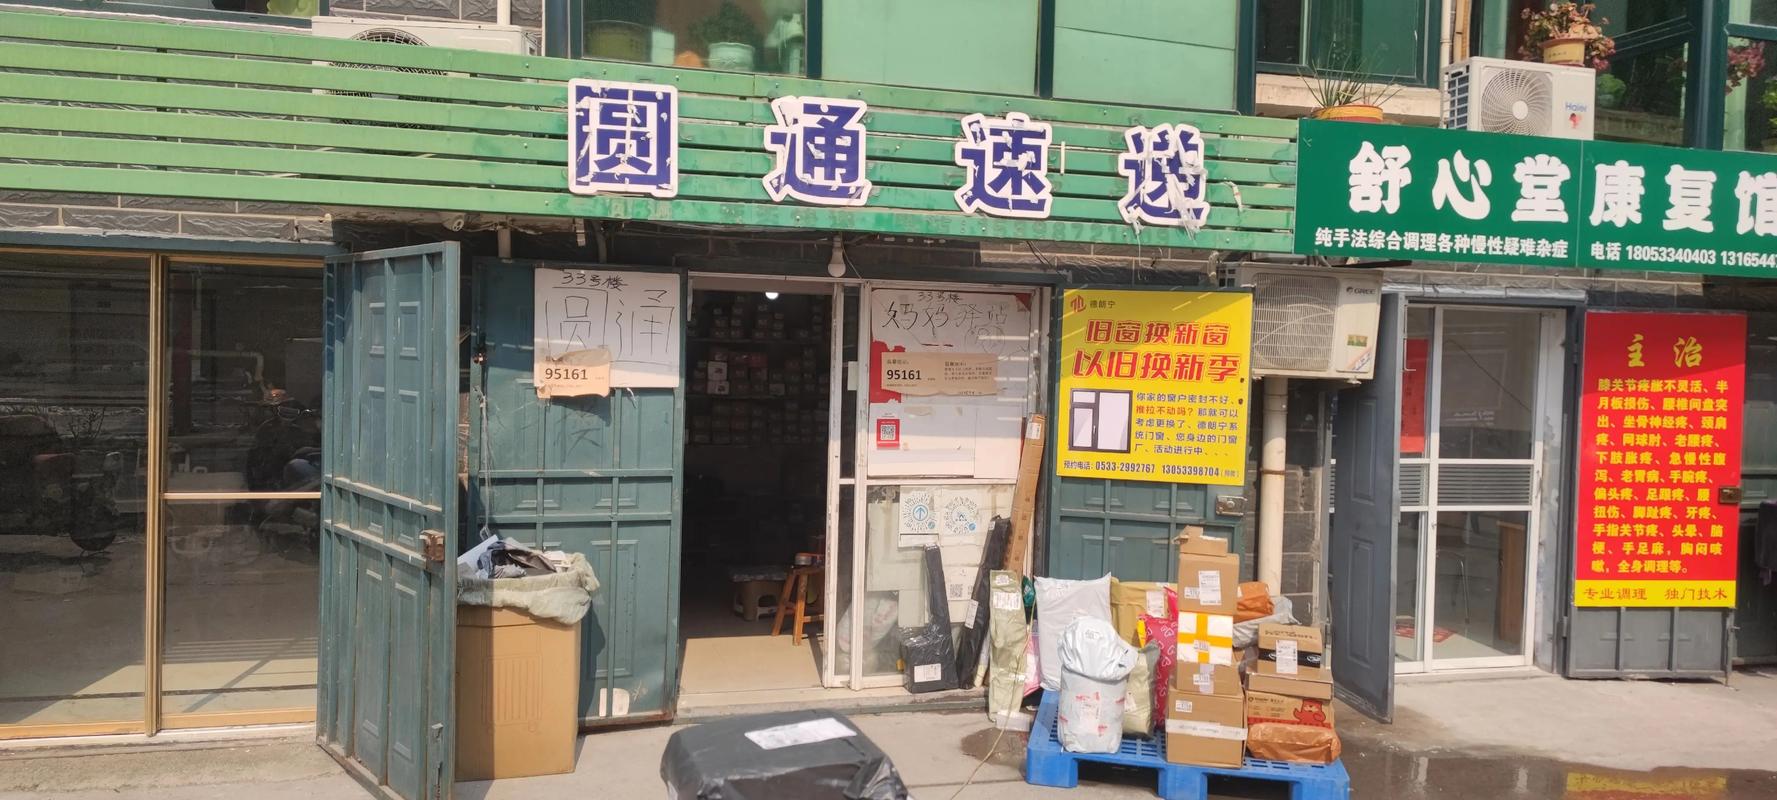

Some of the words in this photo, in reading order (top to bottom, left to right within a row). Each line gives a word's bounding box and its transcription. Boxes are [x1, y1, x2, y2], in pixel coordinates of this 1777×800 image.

[1314, 227, 1569, 258] 纯手法综合调理各种慢性疑难杂症
[1590, 241, 1622, 261] 电话
[1626, 245, 1716, 265] 18053340403
[1720, 250, 1777, 268] 1316544
[1086, 319, 1230, 346] 旧窗换新窗
[545, 368, 588, 381] 95161
[886, 369, 922, 381] 95161
[1073, 350, 1241, 382] 以旧换新季
